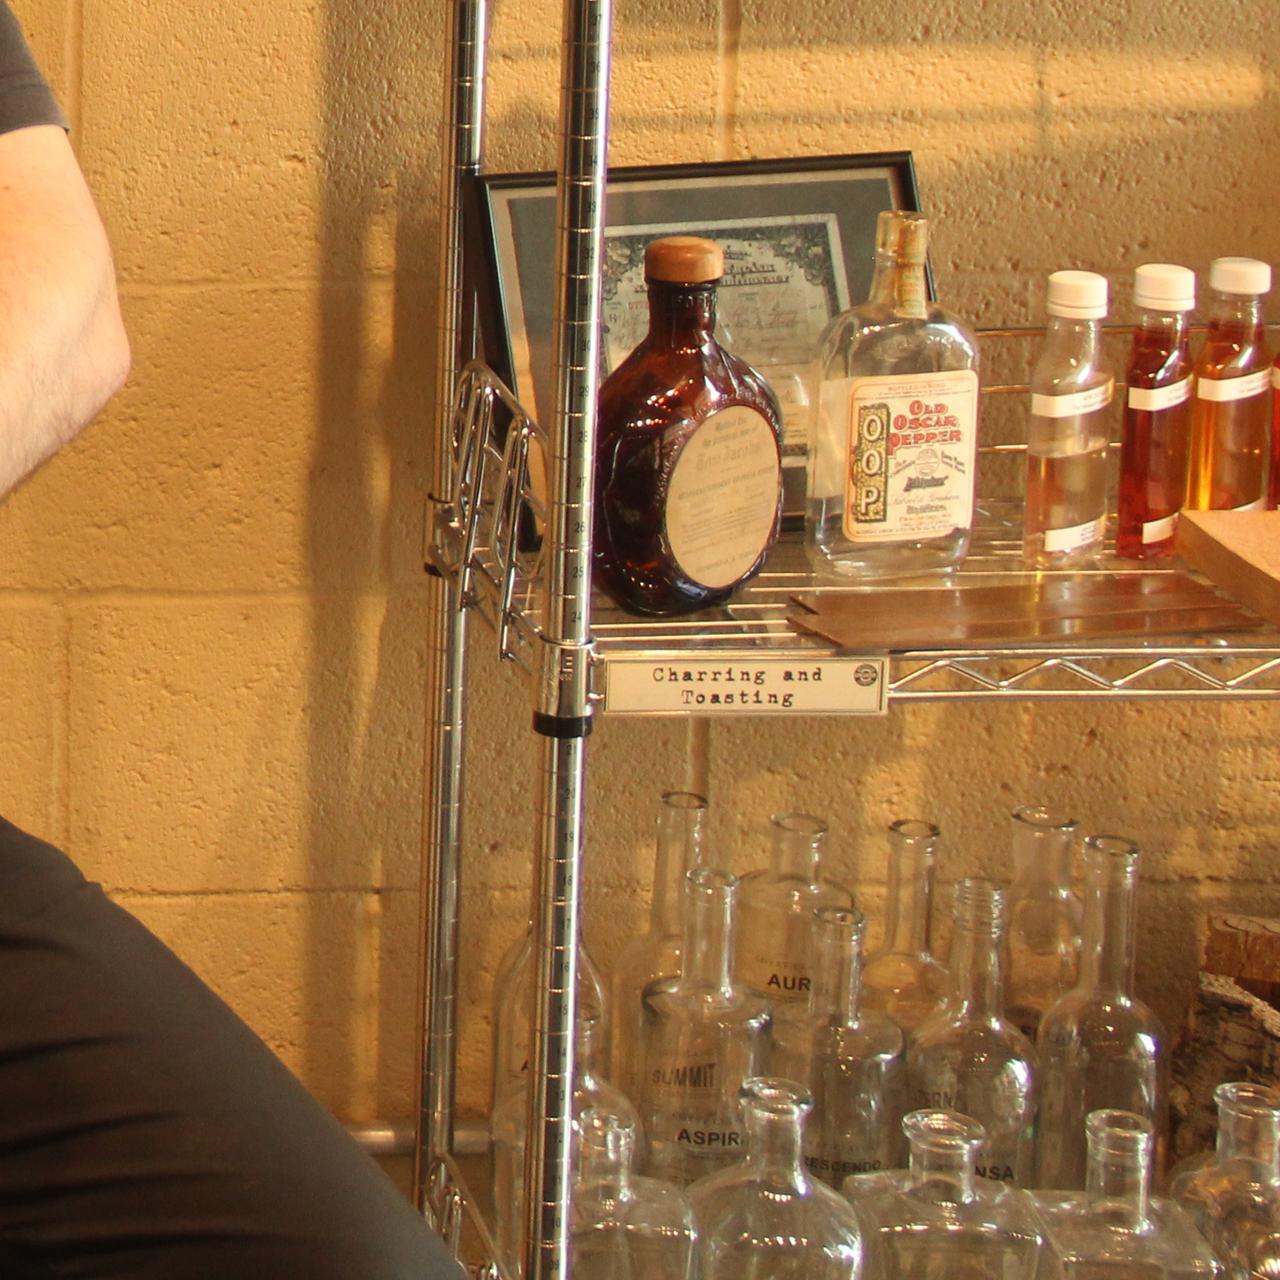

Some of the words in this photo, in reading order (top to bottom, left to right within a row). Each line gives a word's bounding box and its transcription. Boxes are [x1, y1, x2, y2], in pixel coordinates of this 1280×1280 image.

[909, 399, 949, 416] OLD
[892, 414, 962, 431] OSCAR
[887, 429, 962, 456] PEPPER
[652, 667, 766, 685] Charring
[783, 667, 823, 682] and
[681, 689, 794, 707] Toasting
[767, 974, 816, 994] AUR
[651, 1062, 716, 1089] SUMMIT
[677, 1127, 742, 1148] ASPIR
